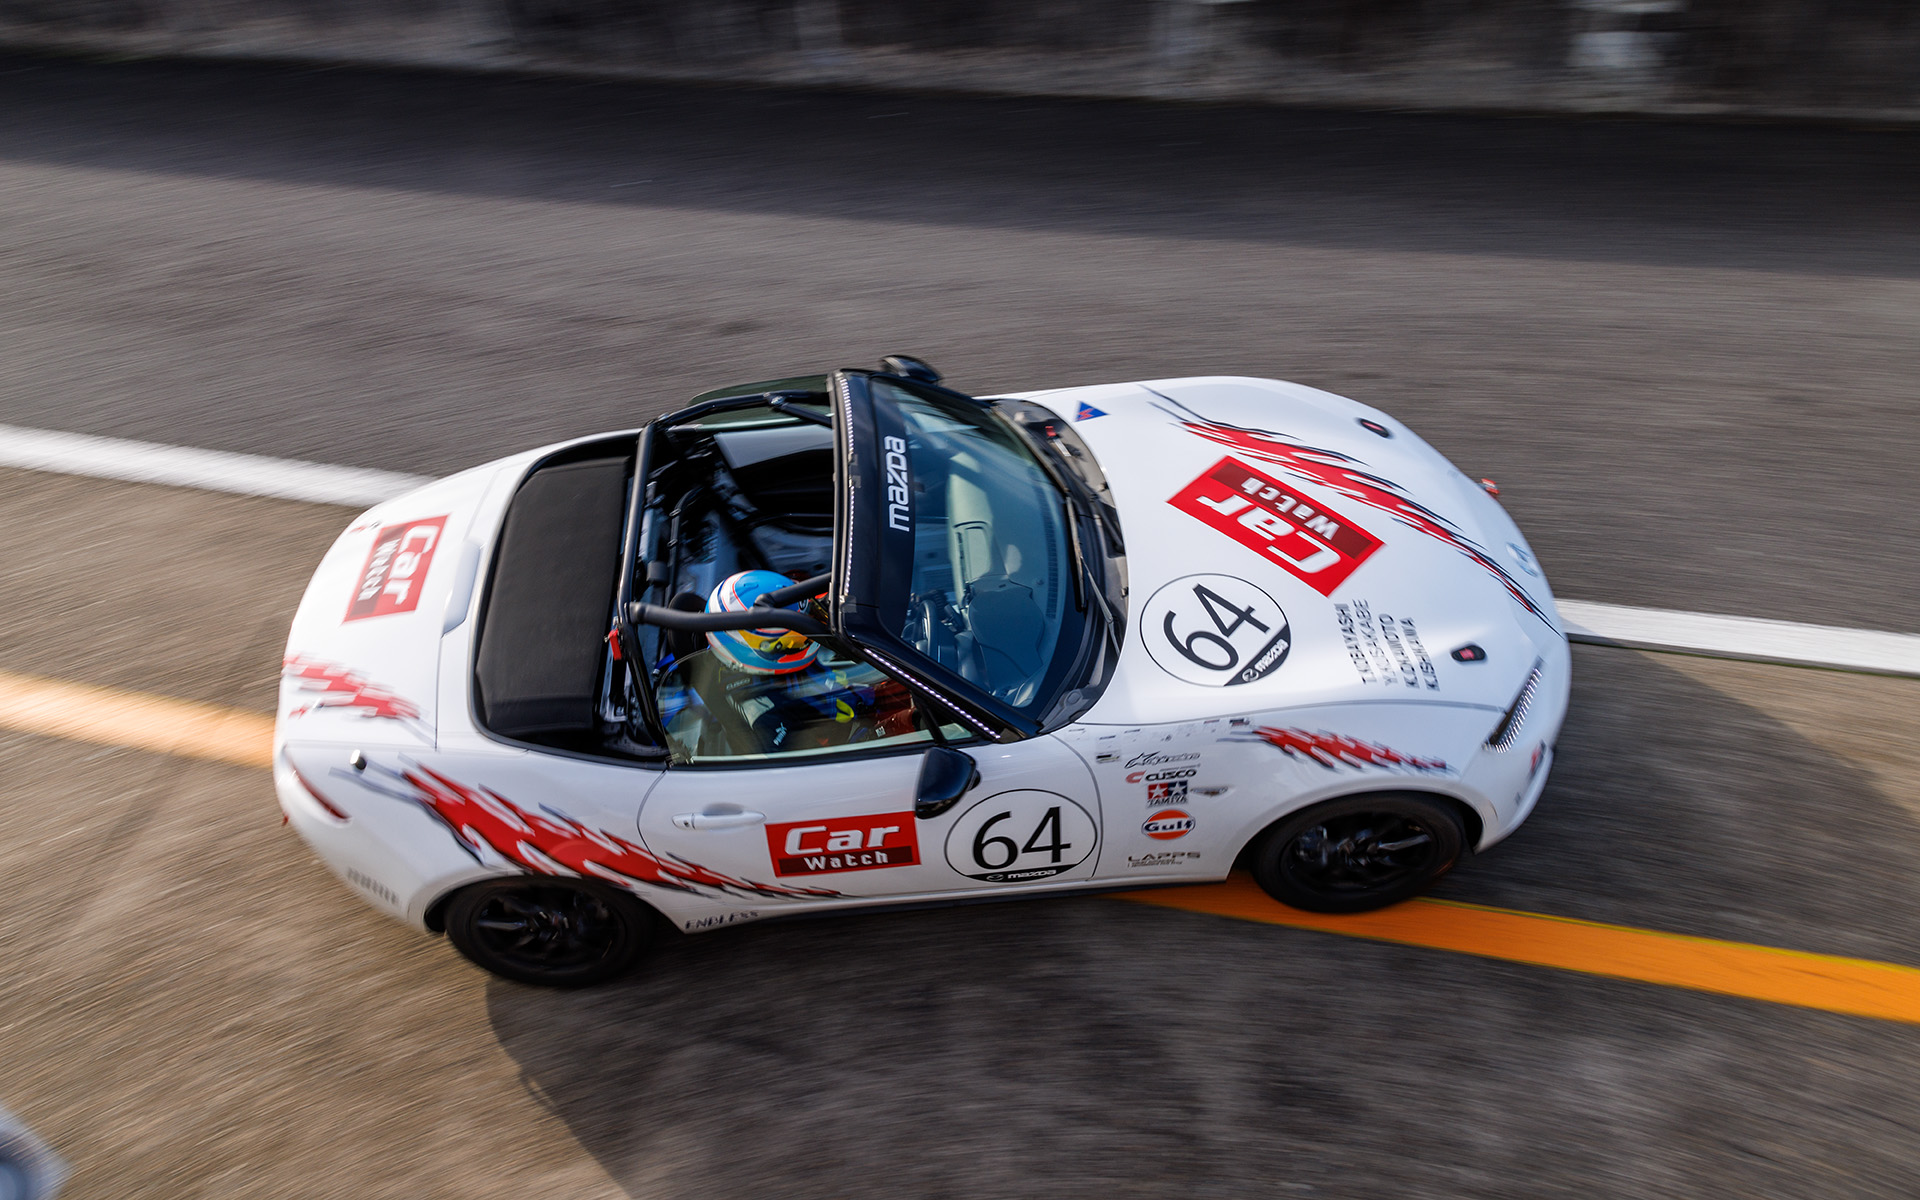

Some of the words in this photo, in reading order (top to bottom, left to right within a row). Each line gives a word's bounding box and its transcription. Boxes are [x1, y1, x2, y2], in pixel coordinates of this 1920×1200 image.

[883, 435, 910, 532] mazda
[1241, 477, 1340, 540] Watch
[1195, 494, 1341, 574] Car
[382, 525, 441, 605] Car
[1163, 583, 1271, 671] 64
[1254, 638, 1289, 672] mazda
[1145, 768, 1197, 781] CUSCO
[785, 825, 900, 855] Car
[973, 806, 1071, 869] 64
[1144, 821, 1193, 832] Gulf
[803, 851, 889, 871] Watch
[1008, 869, 1057, 879] mazda
